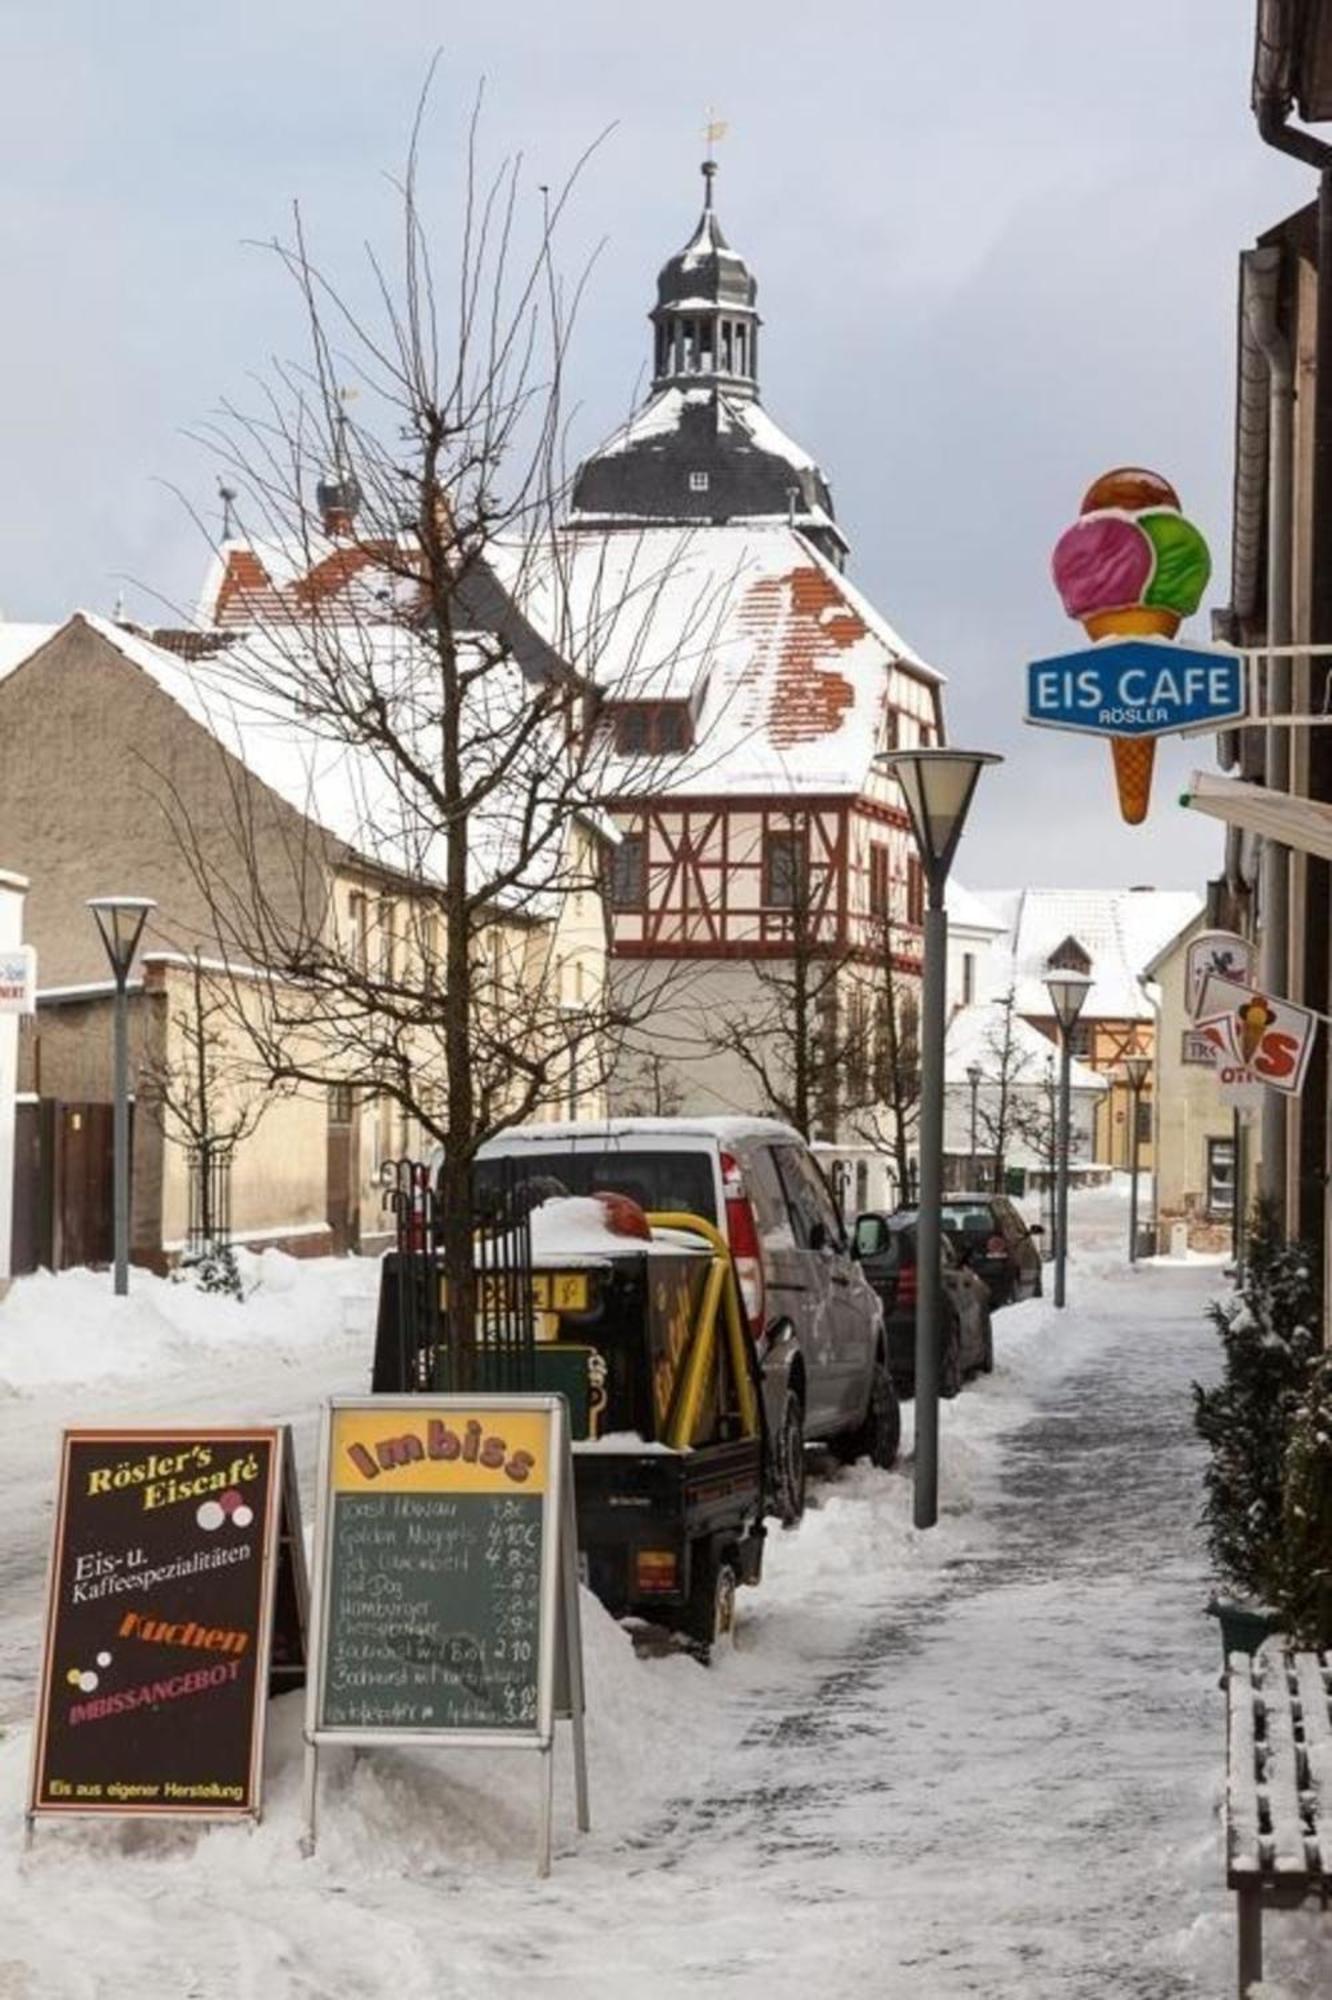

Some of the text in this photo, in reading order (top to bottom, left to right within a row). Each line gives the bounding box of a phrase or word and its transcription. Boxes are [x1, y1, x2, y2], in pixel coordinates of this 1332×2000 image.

[1037, 667, 1231, 709] EIS CAFE
[1100, 706, 1168, 725] RÖSLER
[87, 1444, 213, 1497] Rösler's
[347, 1418, 536, 1483] Imbiss
[142, 1453, 259, 1511] Eiscafé
[72, 1543, 252, 1605] Kaffeespezialitäten
[126, 1547, 150, 1569] u.
[118, 1611, 249, 1653] Kuchen
[68, 1660, 241, 1726] IMBISSANGEBOT
[49, 1780, 244, 1801] Eis aus eigener Herstellung
